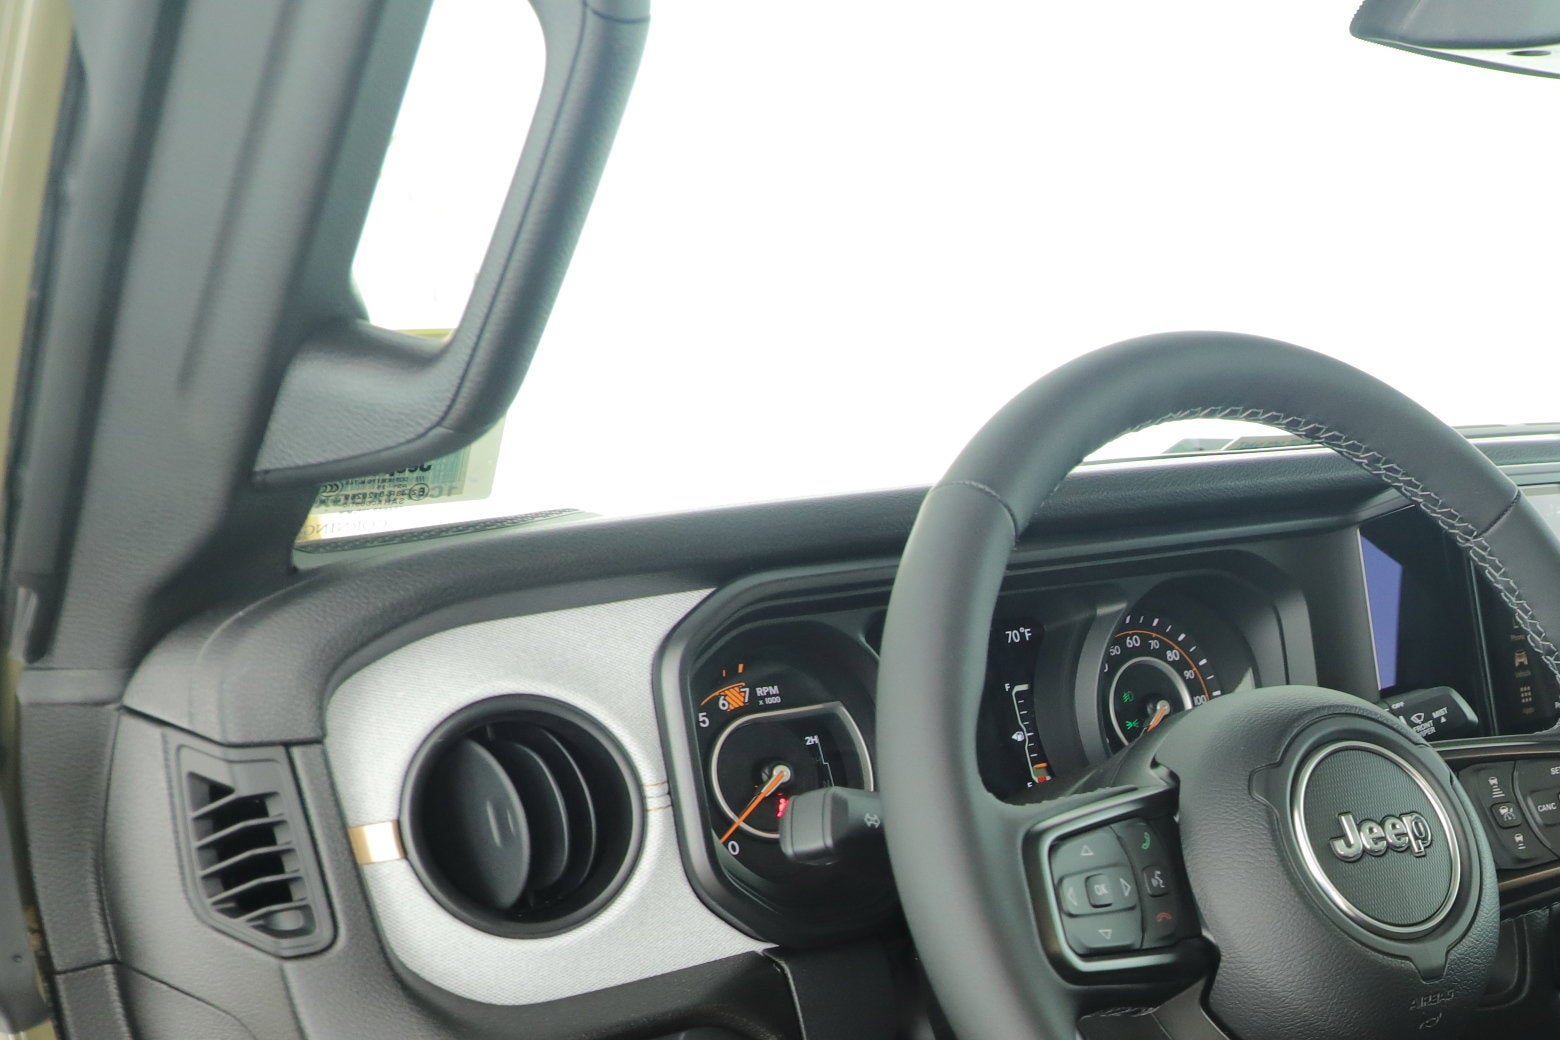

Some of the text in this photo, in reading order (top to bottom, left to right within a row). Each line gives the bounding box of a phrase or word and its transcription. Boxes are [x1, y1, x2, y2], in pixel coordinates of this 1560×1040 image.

[1005, 627, 1033, 644] 70°F
[1126, 635, 1141, 648] 60
[1148, 640, 1160, 650] 70
[1166, 650, 1181, 662] 80
[1184, 669, 1195, 680] 90
[756, 685, 779, 697] RPM
[1004, 683, 1011, 692] F
[740, 687, 750, 703] 7
[1193, 695, 1207, 706] 100
[718, 695, 729, 710] 6
[1432, 707, 1448, 719] MIST
[699, 712, 710, 728] 5
[804, 735, 819, 745] 2H
[1537, 801, 1557, 813] CANC
[1329, 811, 1433, 863] Jeep
[727, 841, 740, 855] 0
[1094, 883, 1109, 896] OK
